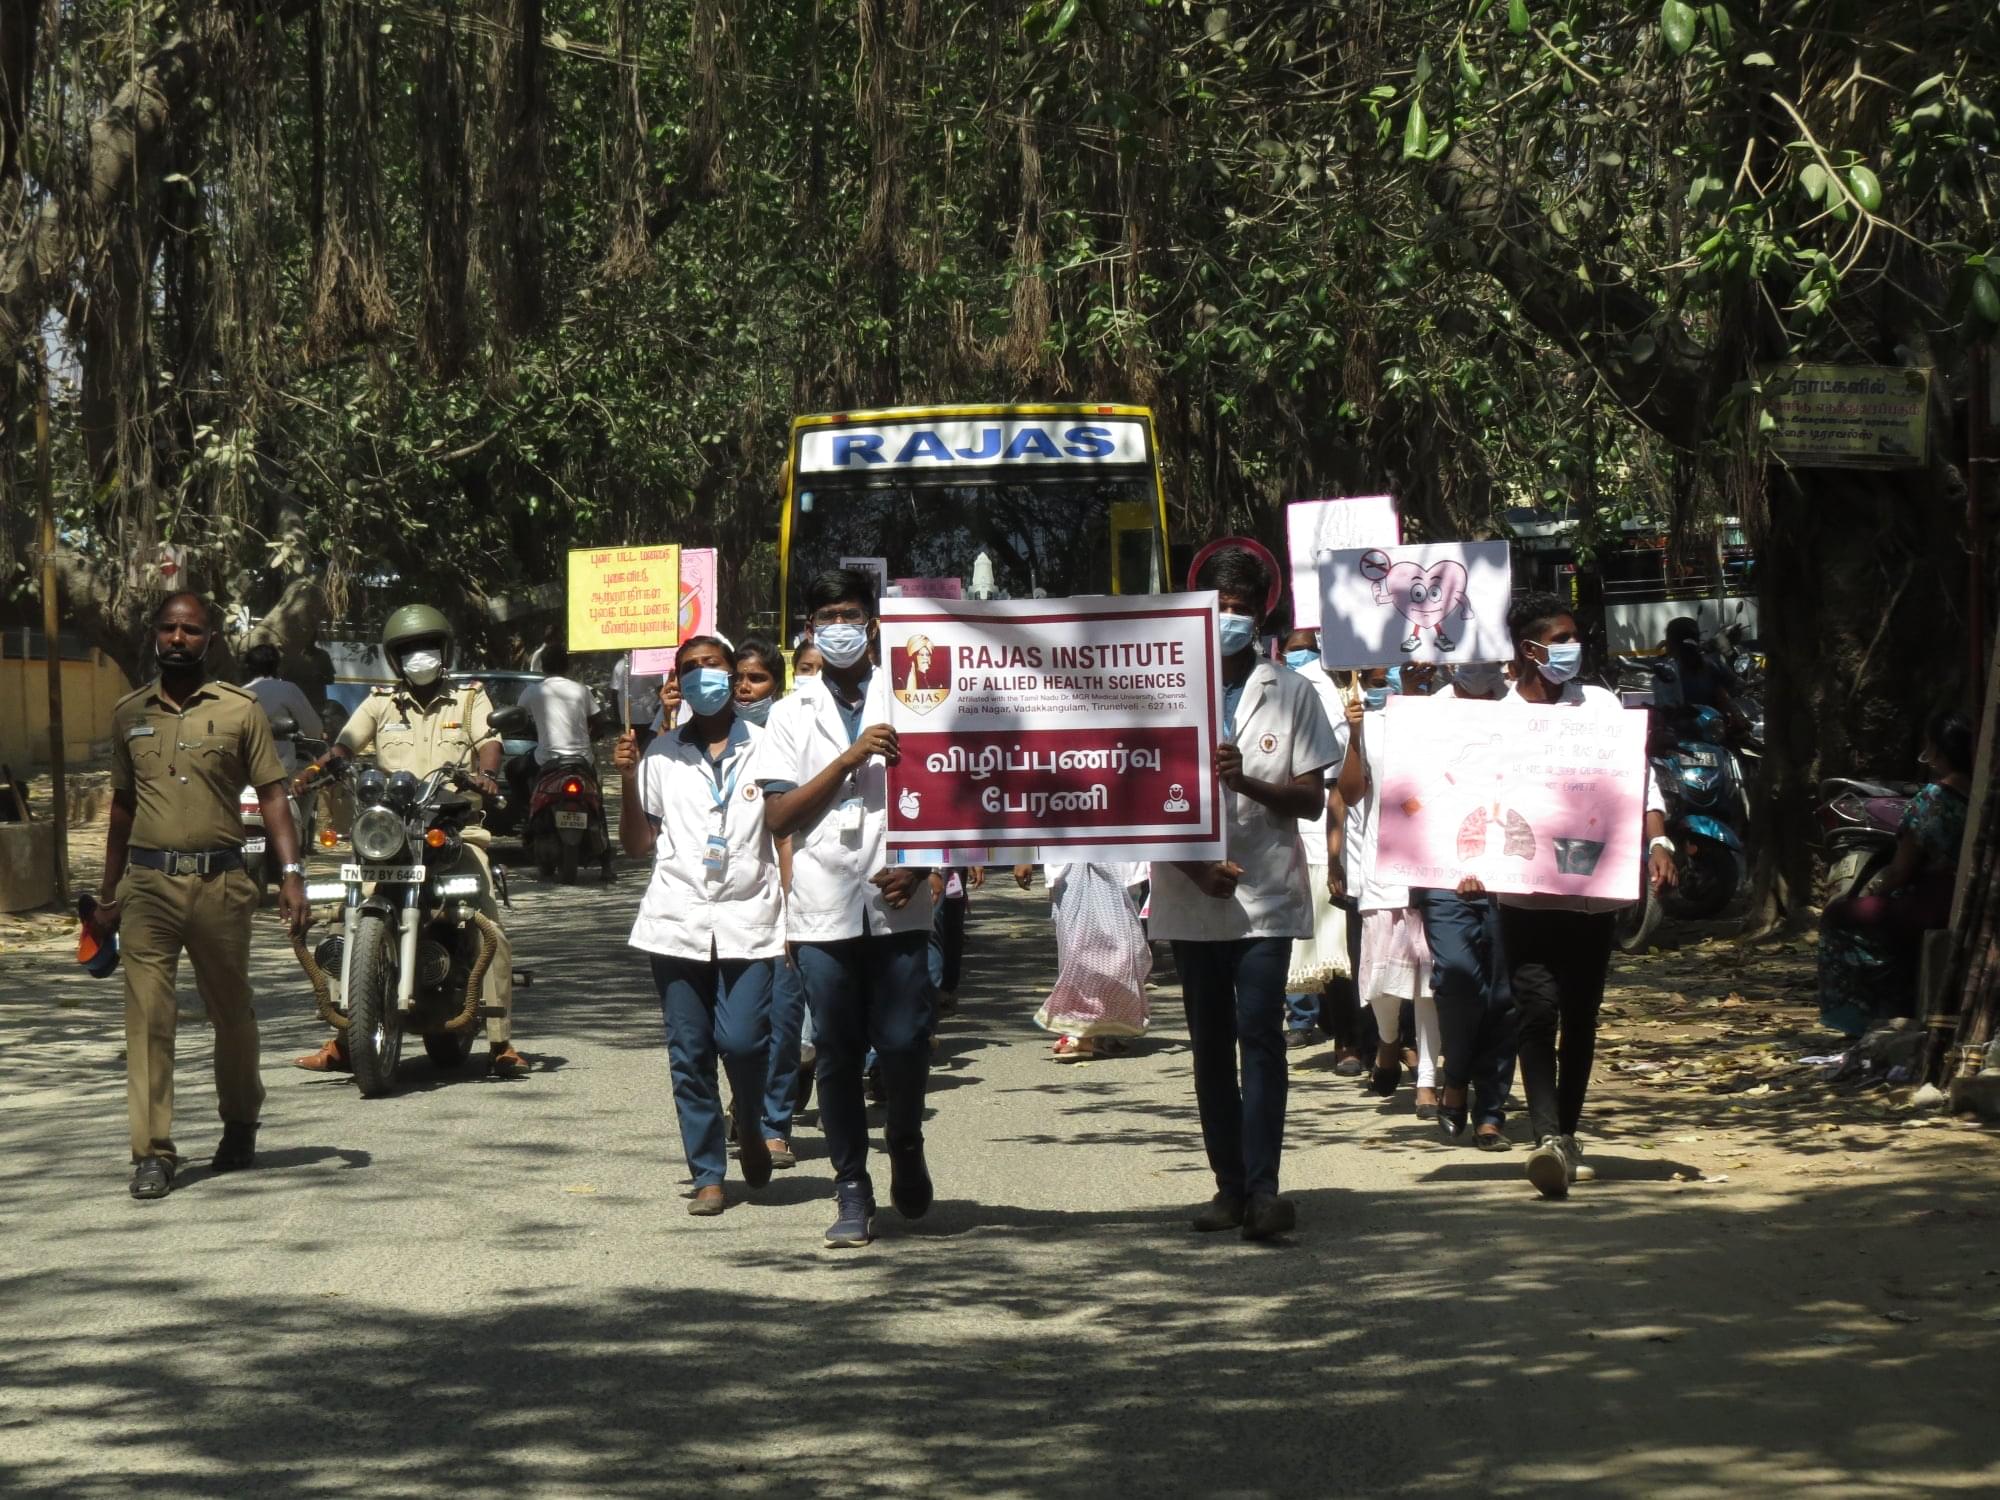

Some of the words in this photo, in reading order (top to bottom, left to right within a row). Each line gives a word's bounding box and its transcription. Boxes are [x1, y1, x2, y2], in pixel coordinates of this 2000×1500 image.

[832, 426, 1116, 465] RAJAS
[958, 645, 1043, 669] RAJAS
[1052, 641, 1185, 669] INSTITUTE
[958, 676, 977, 692] OF
[983, 675, 1037, 691] ALLIED
[1043, 674, 1103, 690] HEALTH
[1108, 672, 1186, 690] SCIENCES
[904, 693, 940, 704] RAJAS
[1020, 694, 1039, 702] Tamil
[958, 705, 979, 715] Raja
[1014, 704, 1089, 714] Vadakkangulam,
[1091, 702, 1139, 711] Tirunelveli
[1147, 702, 1165, 710] 627
[1527, 718, 1549, 733] QUIT
[925, 742, 1162, 779] விழிப்புணர்வு
[981, 784, 1108, 818] பேரணி
[344, 869, 359, 880] TN
[362, 869, 375, 881] 72
[378, 869, 394, 881] BY
